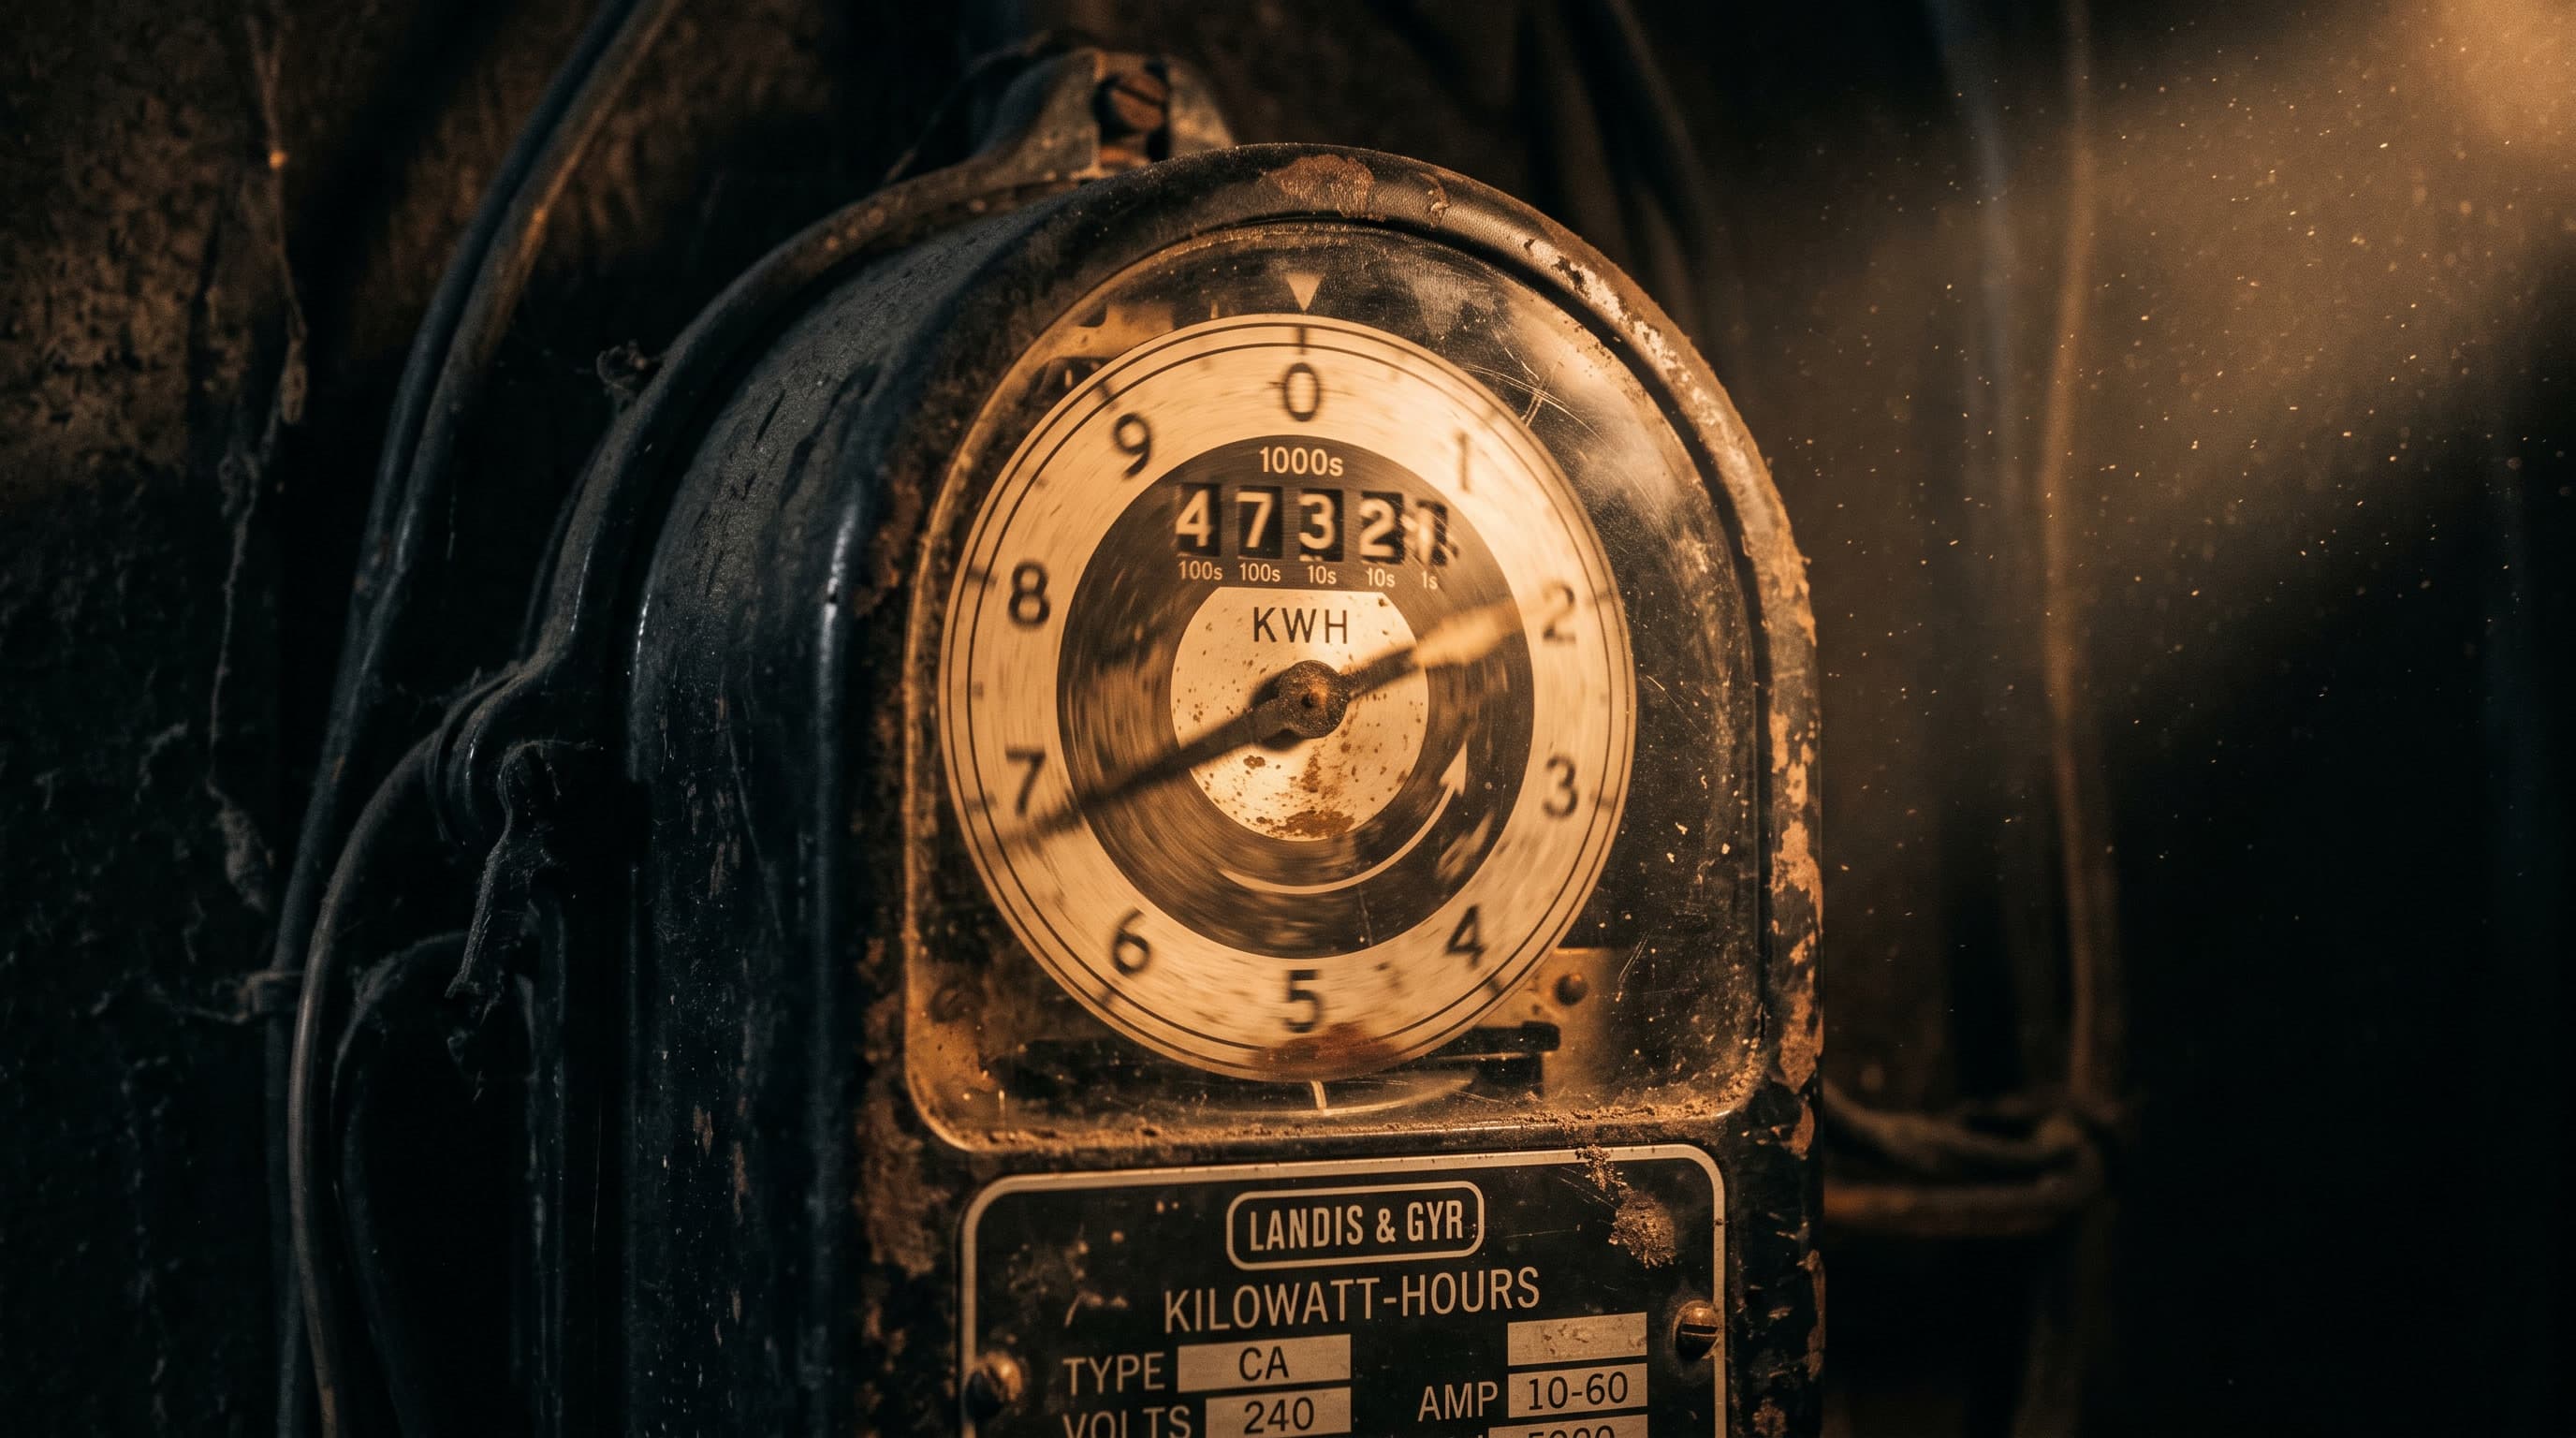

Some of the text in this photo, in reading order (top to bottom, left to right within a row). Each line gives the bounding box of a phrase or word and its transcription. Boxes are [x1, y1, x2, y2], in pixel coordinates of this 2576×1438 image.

[1279, 361, 1323, 422] 0
[1112, 413, 1154, 478] 9
[1259, 446, 1344, 477] 1000s
[1452, 429, 1474, 492] 1
[1006, 561, 1052, 629] 8
[1178, 560, 1439, 591] 100s 100s 10s 10s 1s
[1252, 606, 1348, 645] KWH
[1541, 579, 1577, 646] 2
[1005, 747, 1046, 817] 7
[1543, 756, 1578, 819] 3
[1109, 908, 1153, 976] 6
[1446, 904, 1486, 970] 4
[1281, 970, 1324, 1034] 5
[1249, 1198, 1464, 1252] LANDIS & GYR
[1163, 1265, 1542, 1334] KILOWATT-HOURS
[1061, 1344, 1290, 1397] TYPE CA
[1416, 1371, 1629, 1423] AMP 10-60
[1061, 1396, 1315, 1438] VOLTS 240
